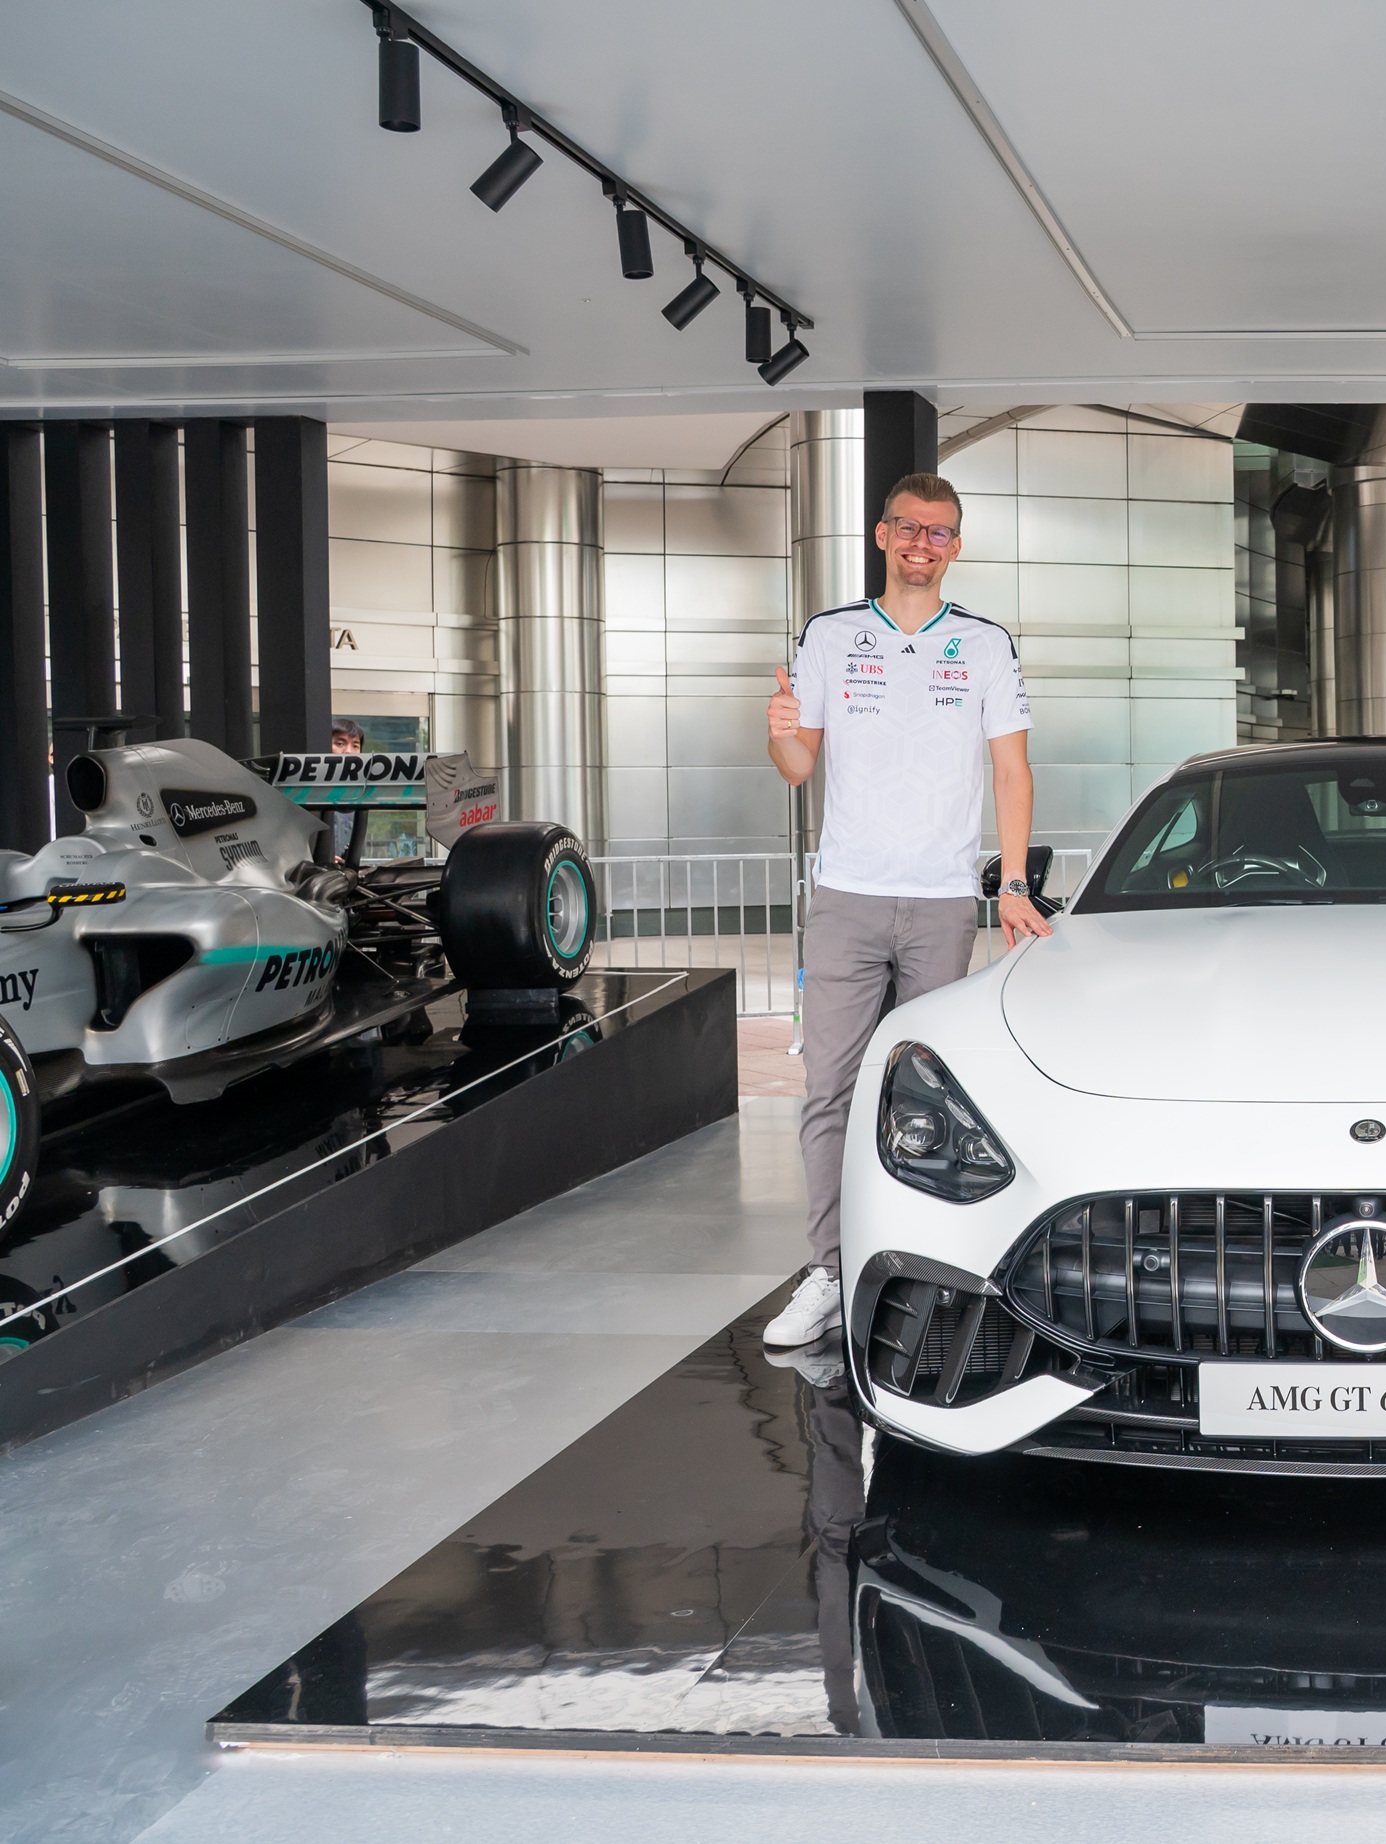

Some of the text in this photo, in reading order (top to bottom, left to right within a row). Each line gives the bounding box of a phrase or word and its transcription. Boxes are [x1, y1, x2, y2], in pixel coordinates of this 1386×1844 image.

[860, 664, 884, 674] UBS
[932, 670, 968, 680] INEOS
[853, 691, 886, 699] Snapdragon
[935, 697, 963, 707] HPE
[277, 754, 438, 782] PETRON
[454, 783, 496, 803] BRIDGESTONE
[185, 800, 246, 820] Mercedes-Benz
[459, 803, 497, 827] aabar
[544, 837, 586, 877] BRIDGESTONE
[1246, 1385, 1322, 1411] AMG
[1330, 1385, 1371, 1412] GT
